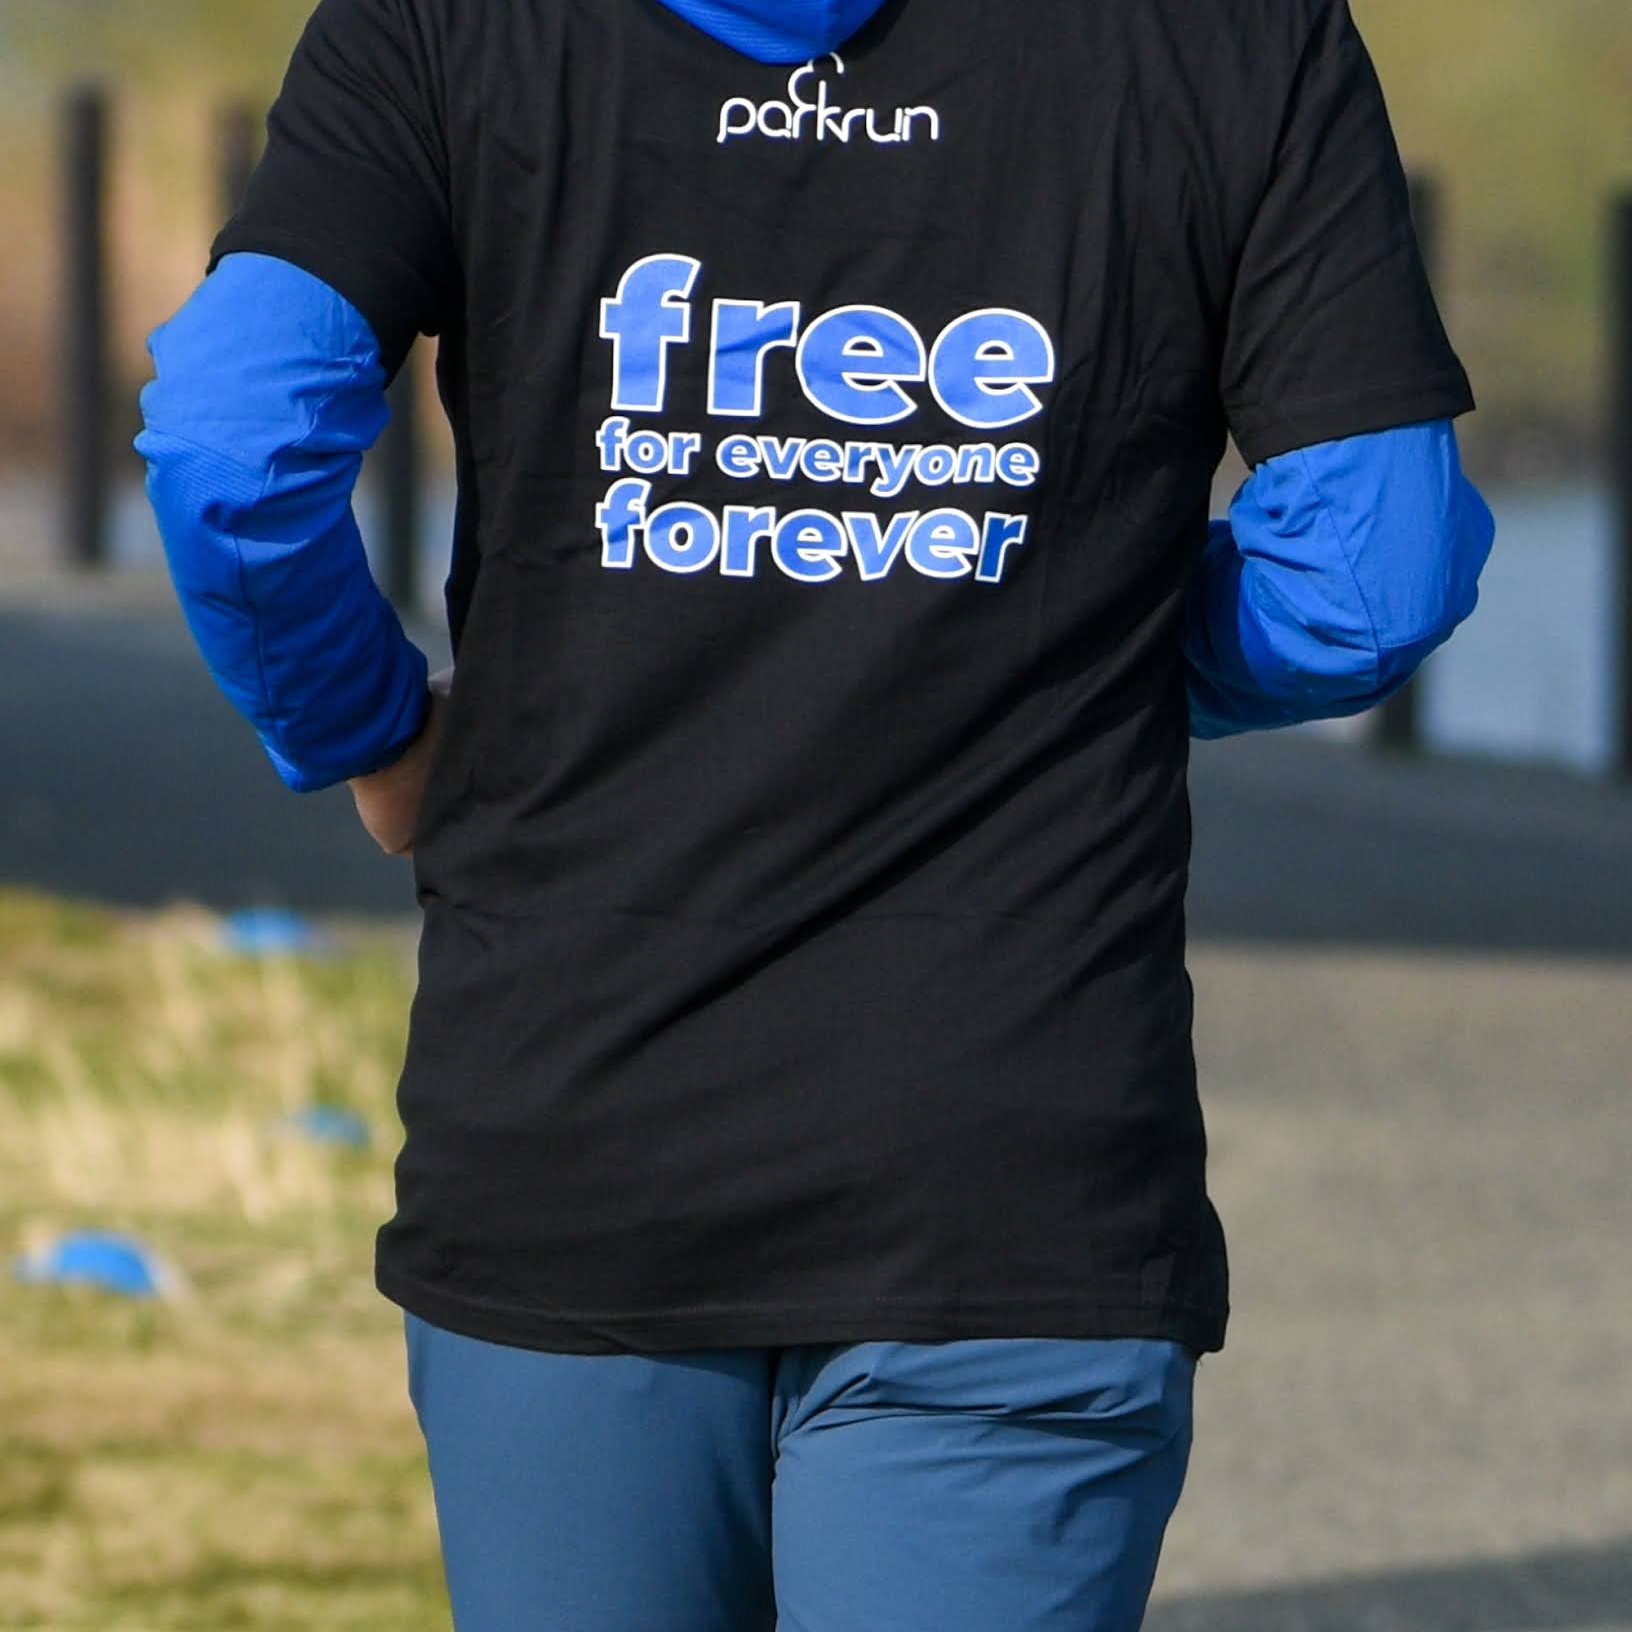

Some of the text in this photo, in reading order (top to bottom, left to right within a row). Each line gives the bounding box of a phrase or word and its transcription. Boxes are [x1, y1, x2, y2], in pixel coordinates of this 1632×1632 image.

[717, 77, 939, 144] parkrun
[599, 252, 1056, 430] free
[596, 415, 1041, 498] for everyone
[595, 476, 1029, 584] forever
